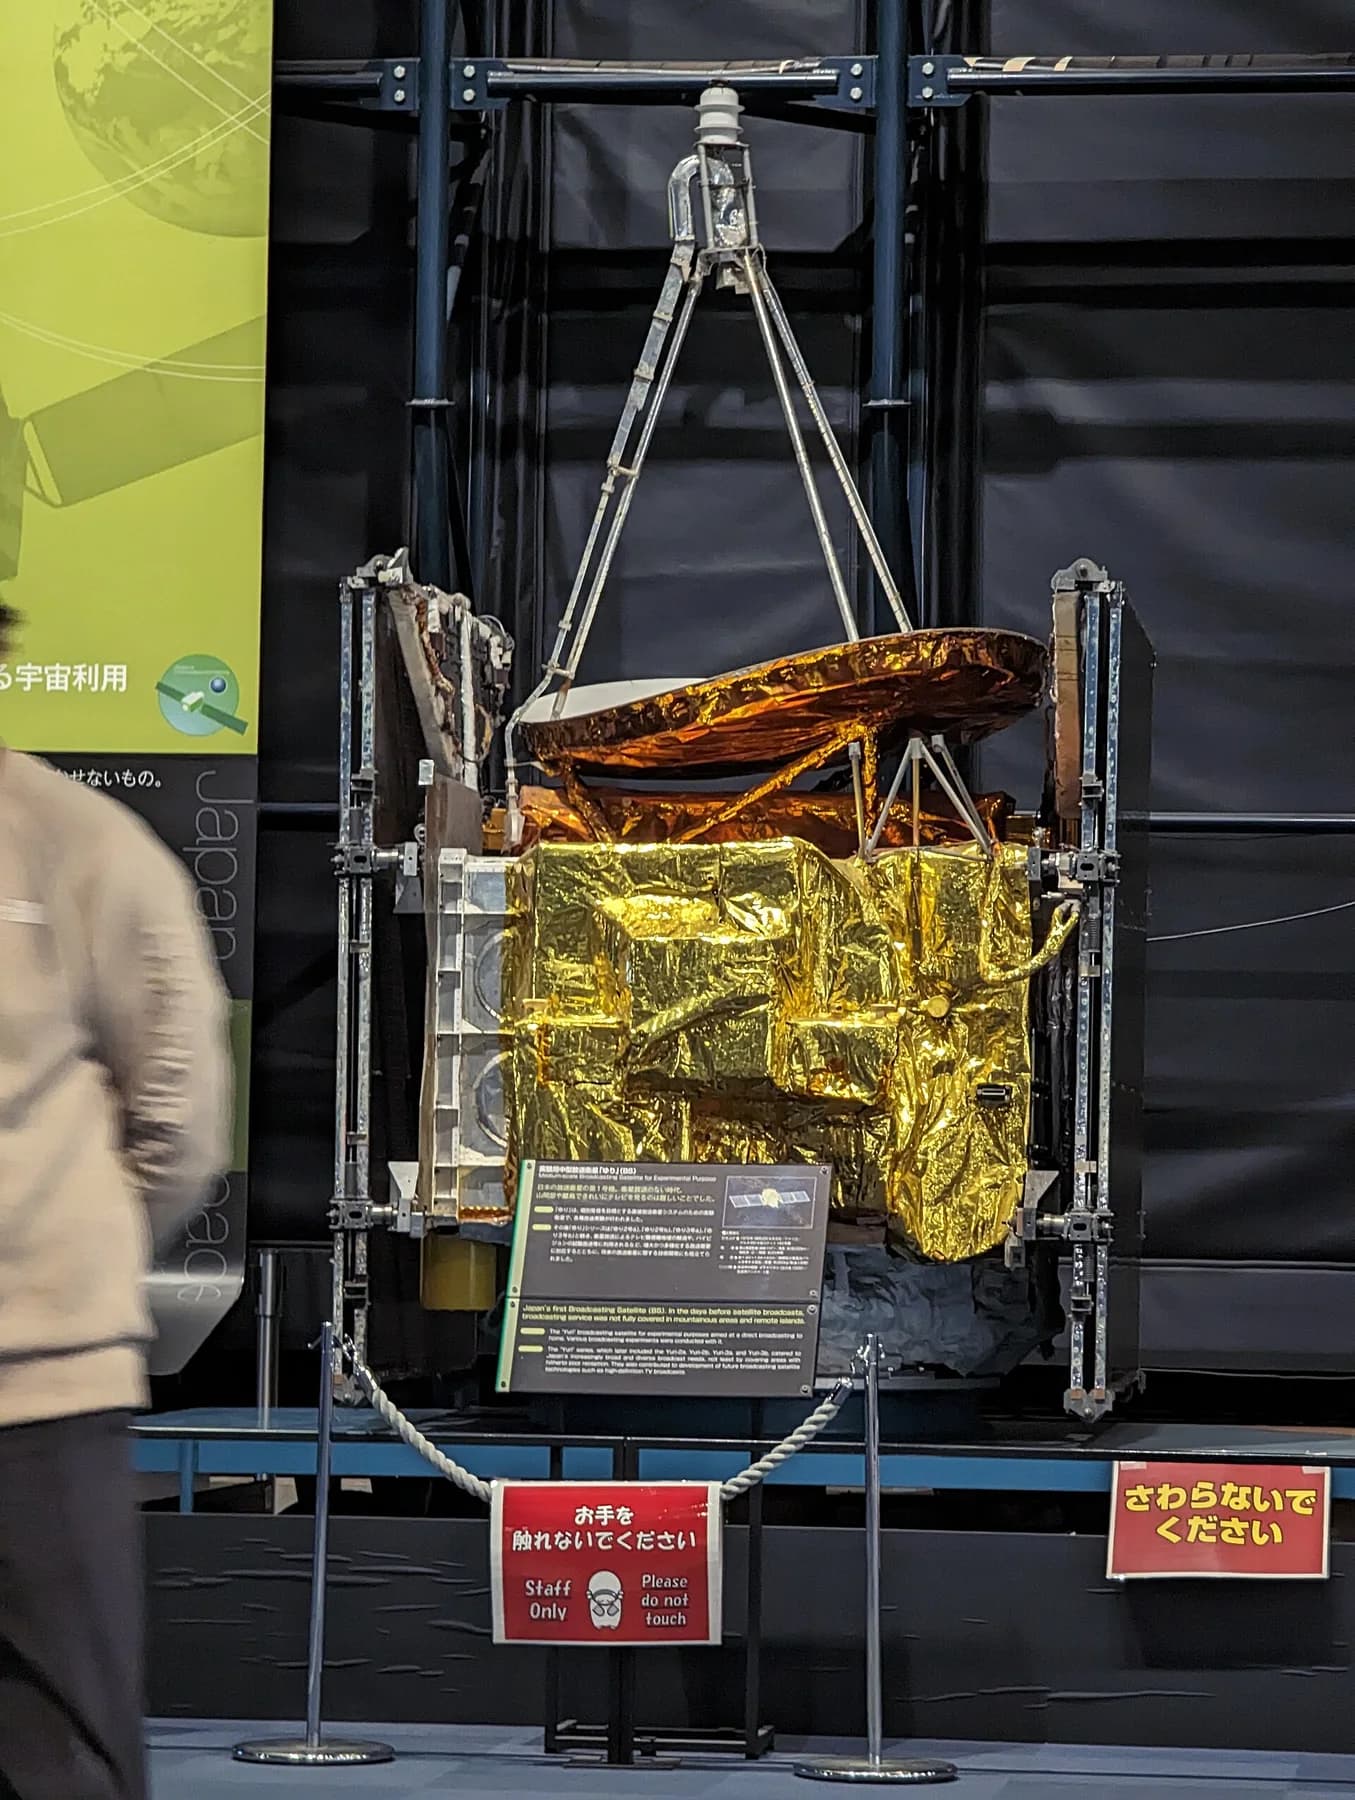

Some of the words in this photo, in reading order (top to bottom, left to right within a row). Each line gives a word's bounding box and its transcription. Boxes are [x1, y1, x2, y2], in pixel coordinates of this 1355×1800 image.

[1124, 1481, 1317, 1515] さわらないで
[575, 1505, 635, 1526] お手を
[1156, 1515, 1284, 1546] ください
[512, 1530, 696, 1552] 触れないでください
[525, 1579, 572, 1597] Staff
[642, 1574, 688, 1589] Please
[641, 1592, 659, 1608] do
[664, 1593, 689, 1608] not
[530, 1602, 568, 1622] Only
[646, 1611, 687, 1626] touch
